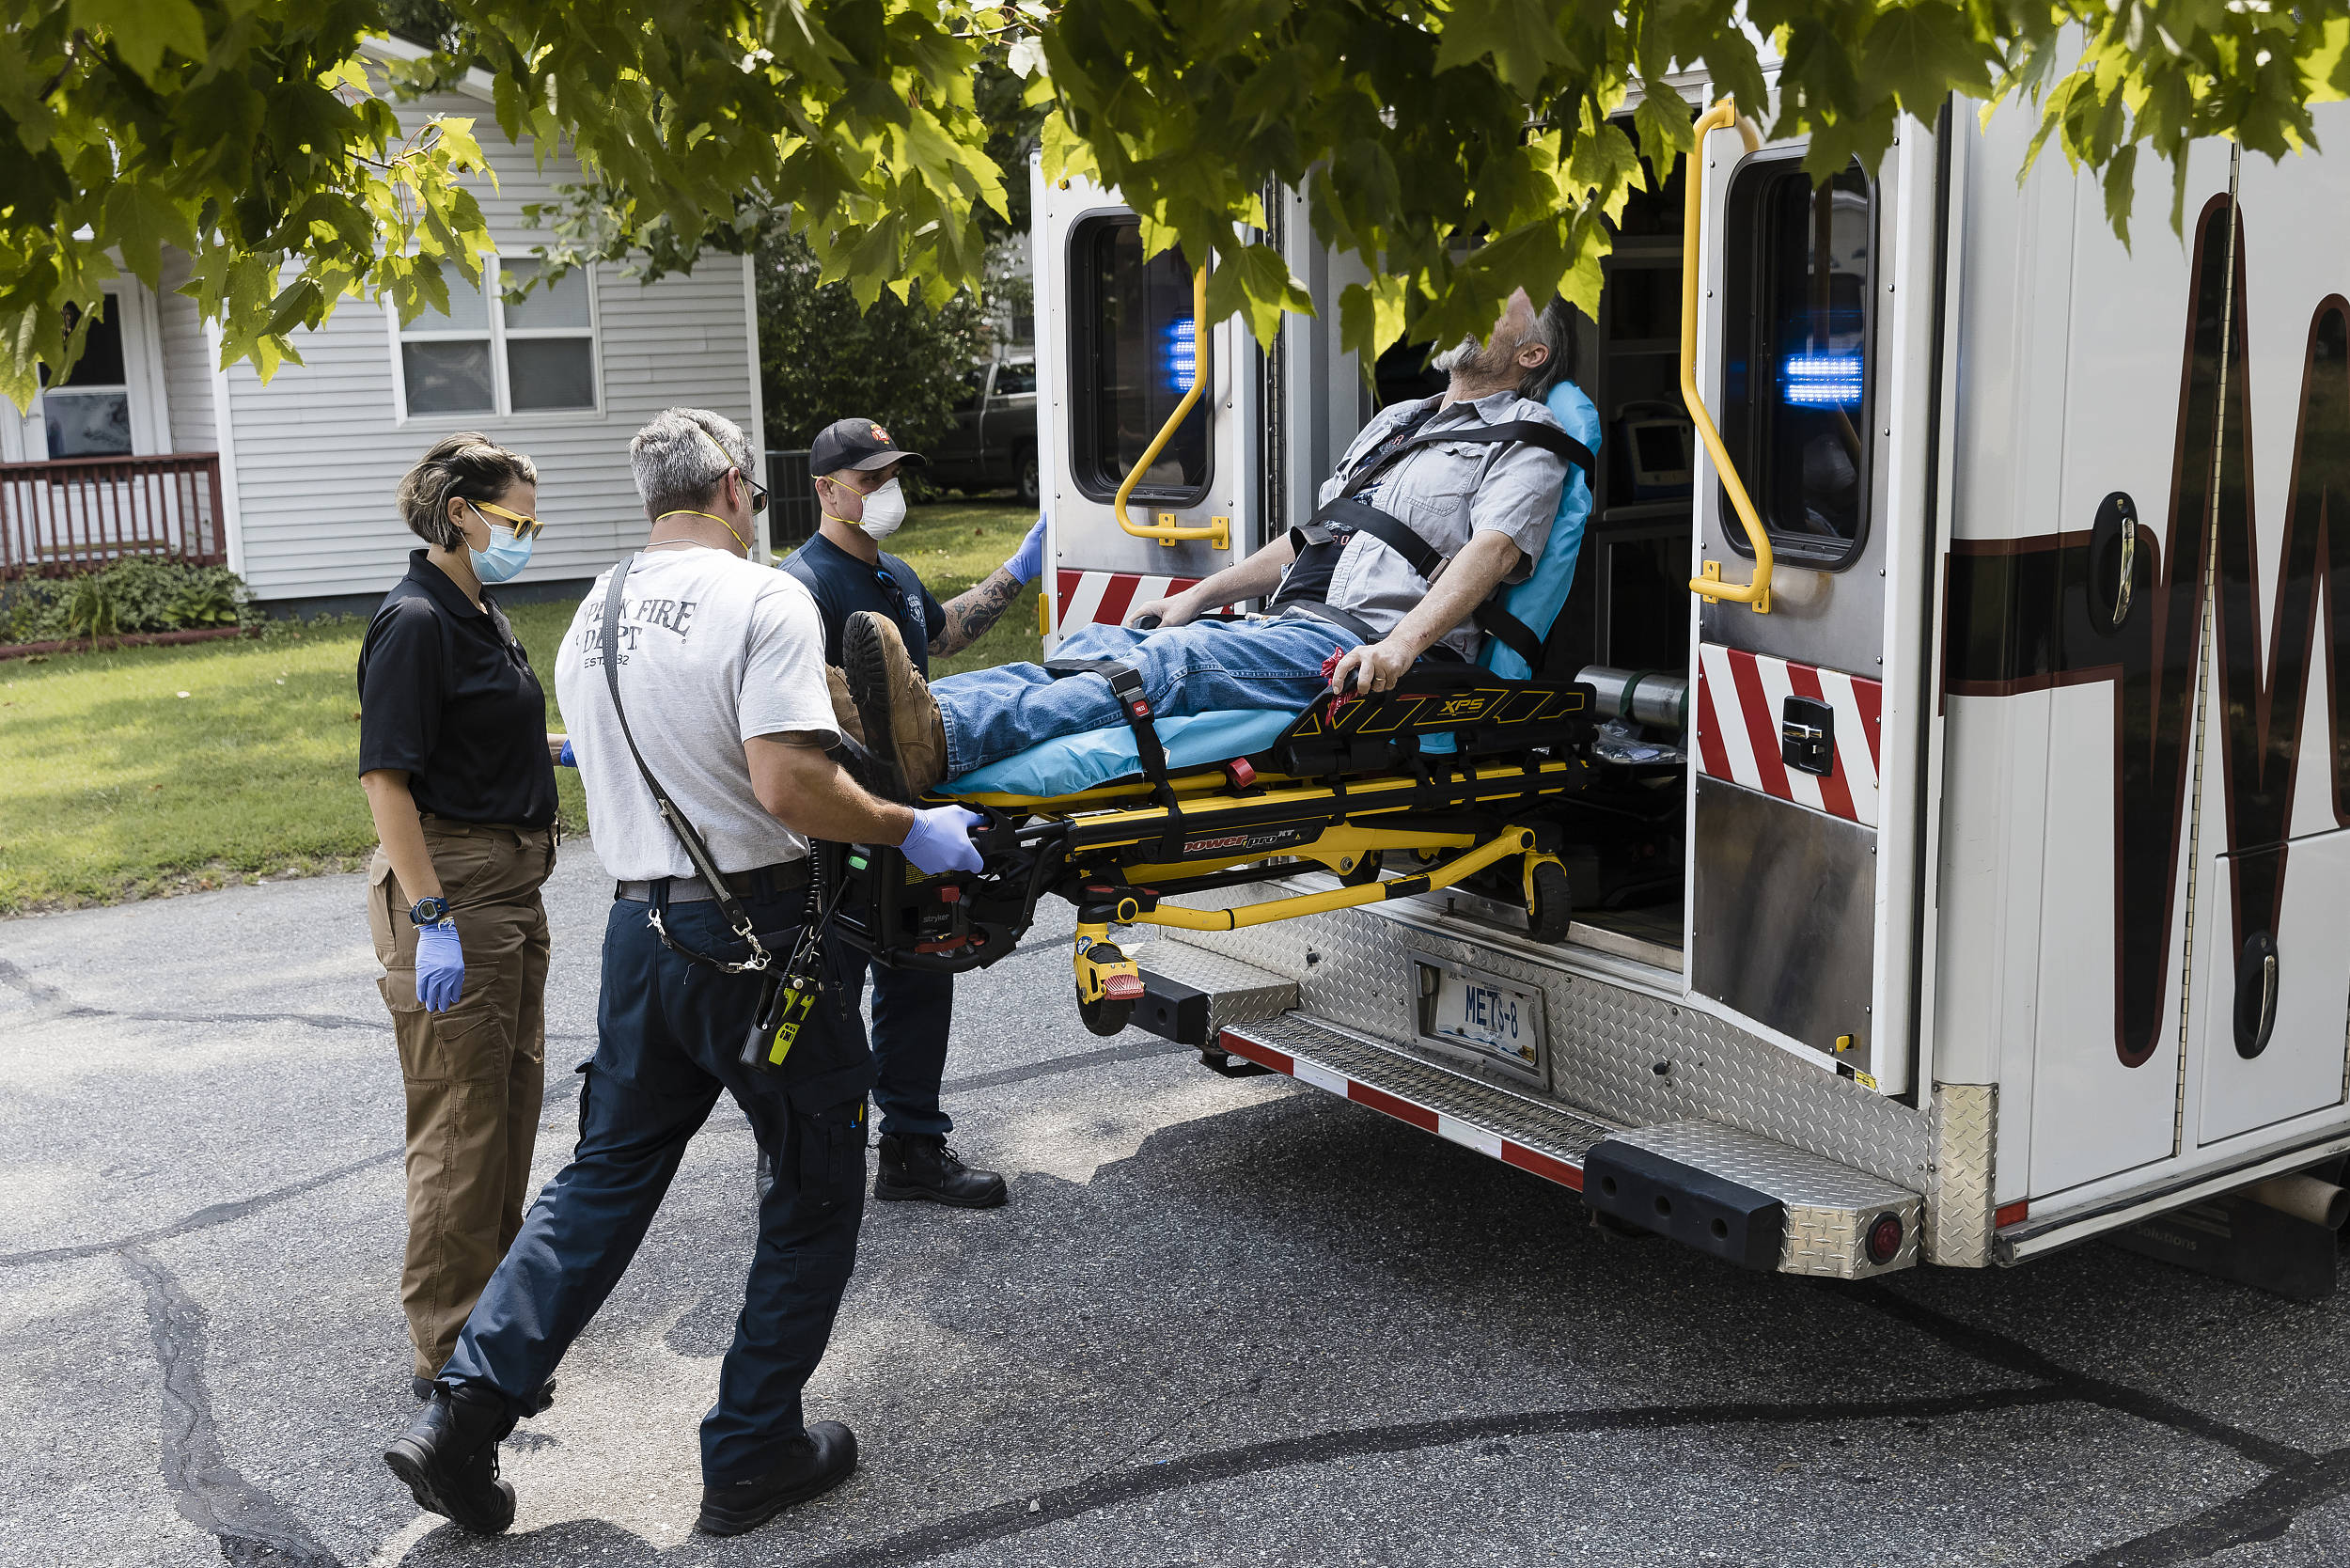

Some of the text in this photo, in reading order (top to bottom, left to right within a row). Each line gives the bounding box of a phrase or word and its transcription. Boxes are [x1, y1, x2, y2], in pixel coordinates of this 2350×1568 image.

[633, 598, 697, 637] FIRE
[1440, 698, 1486, 714] XPS
[923, 912, 950, 924] stryker
[1465, 984, 1518, 1040] METS-8
[2135, 1223, 2198, 1251] Solutions
